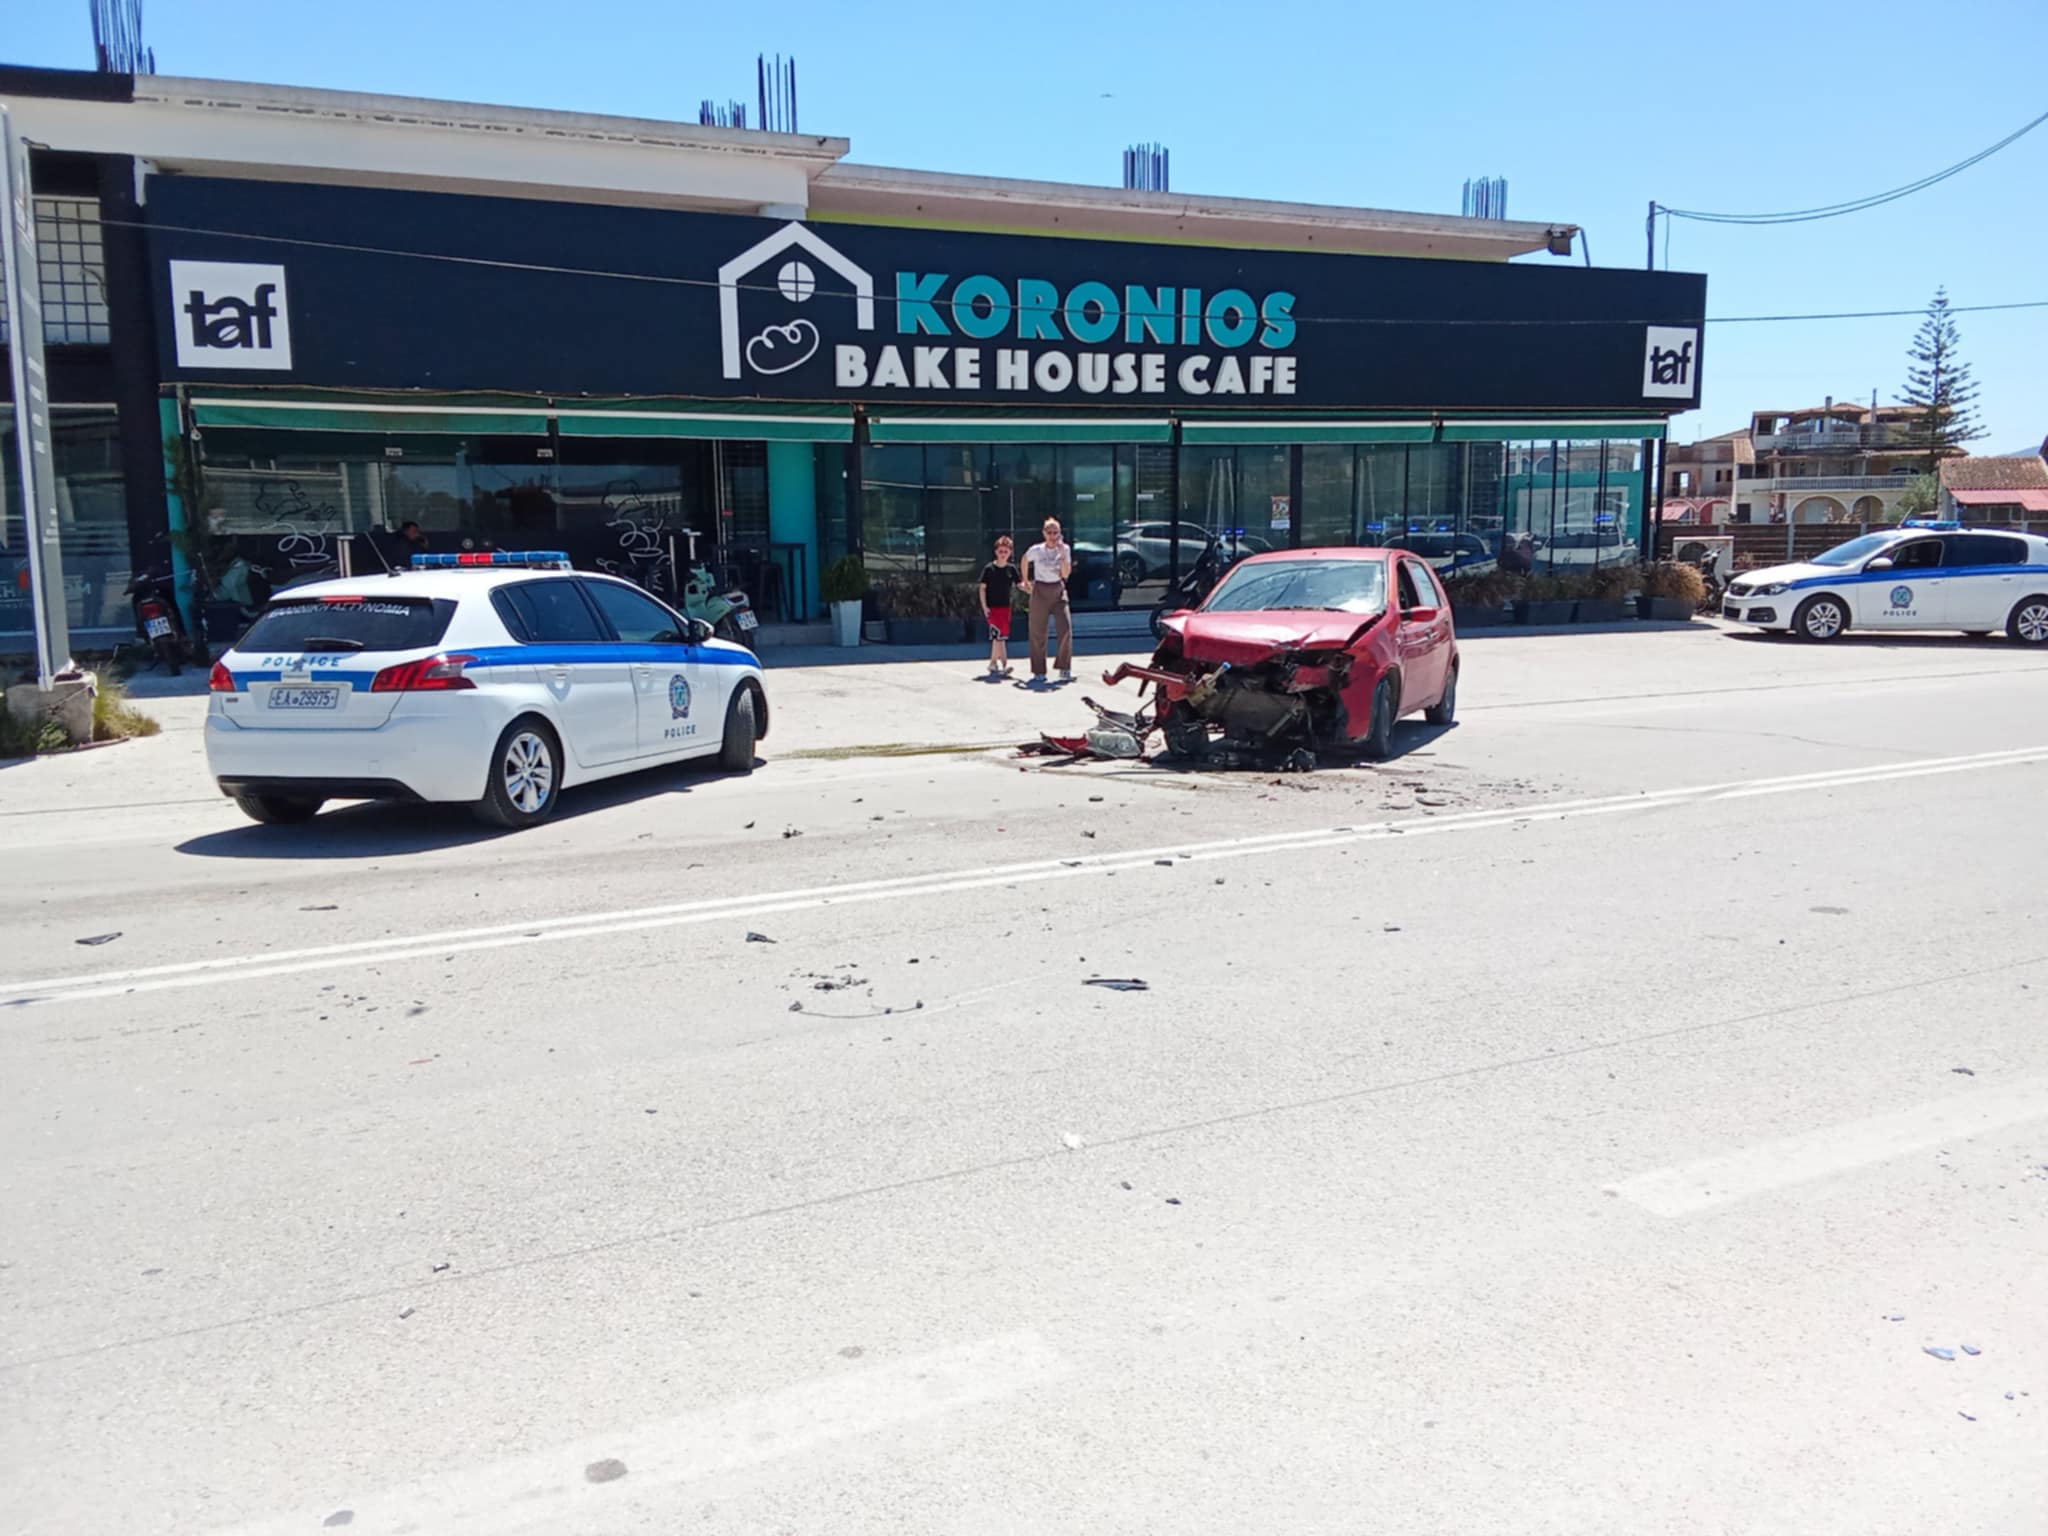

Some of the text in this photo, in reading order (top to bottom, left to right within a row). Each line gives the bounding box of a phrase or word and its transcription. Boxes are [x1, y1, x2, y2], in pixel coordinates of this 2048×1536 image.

[184, 283, 277, 349] taf
[896, 272, 1297, 349] KORONIOS
[835, 344, 1297, 395] BAKE HOUSE CAFE
[1650, 341, 1692, 384] taf
[262, 656, 341, 667] POLICE
[664, 724, 696, 738] POLICE
